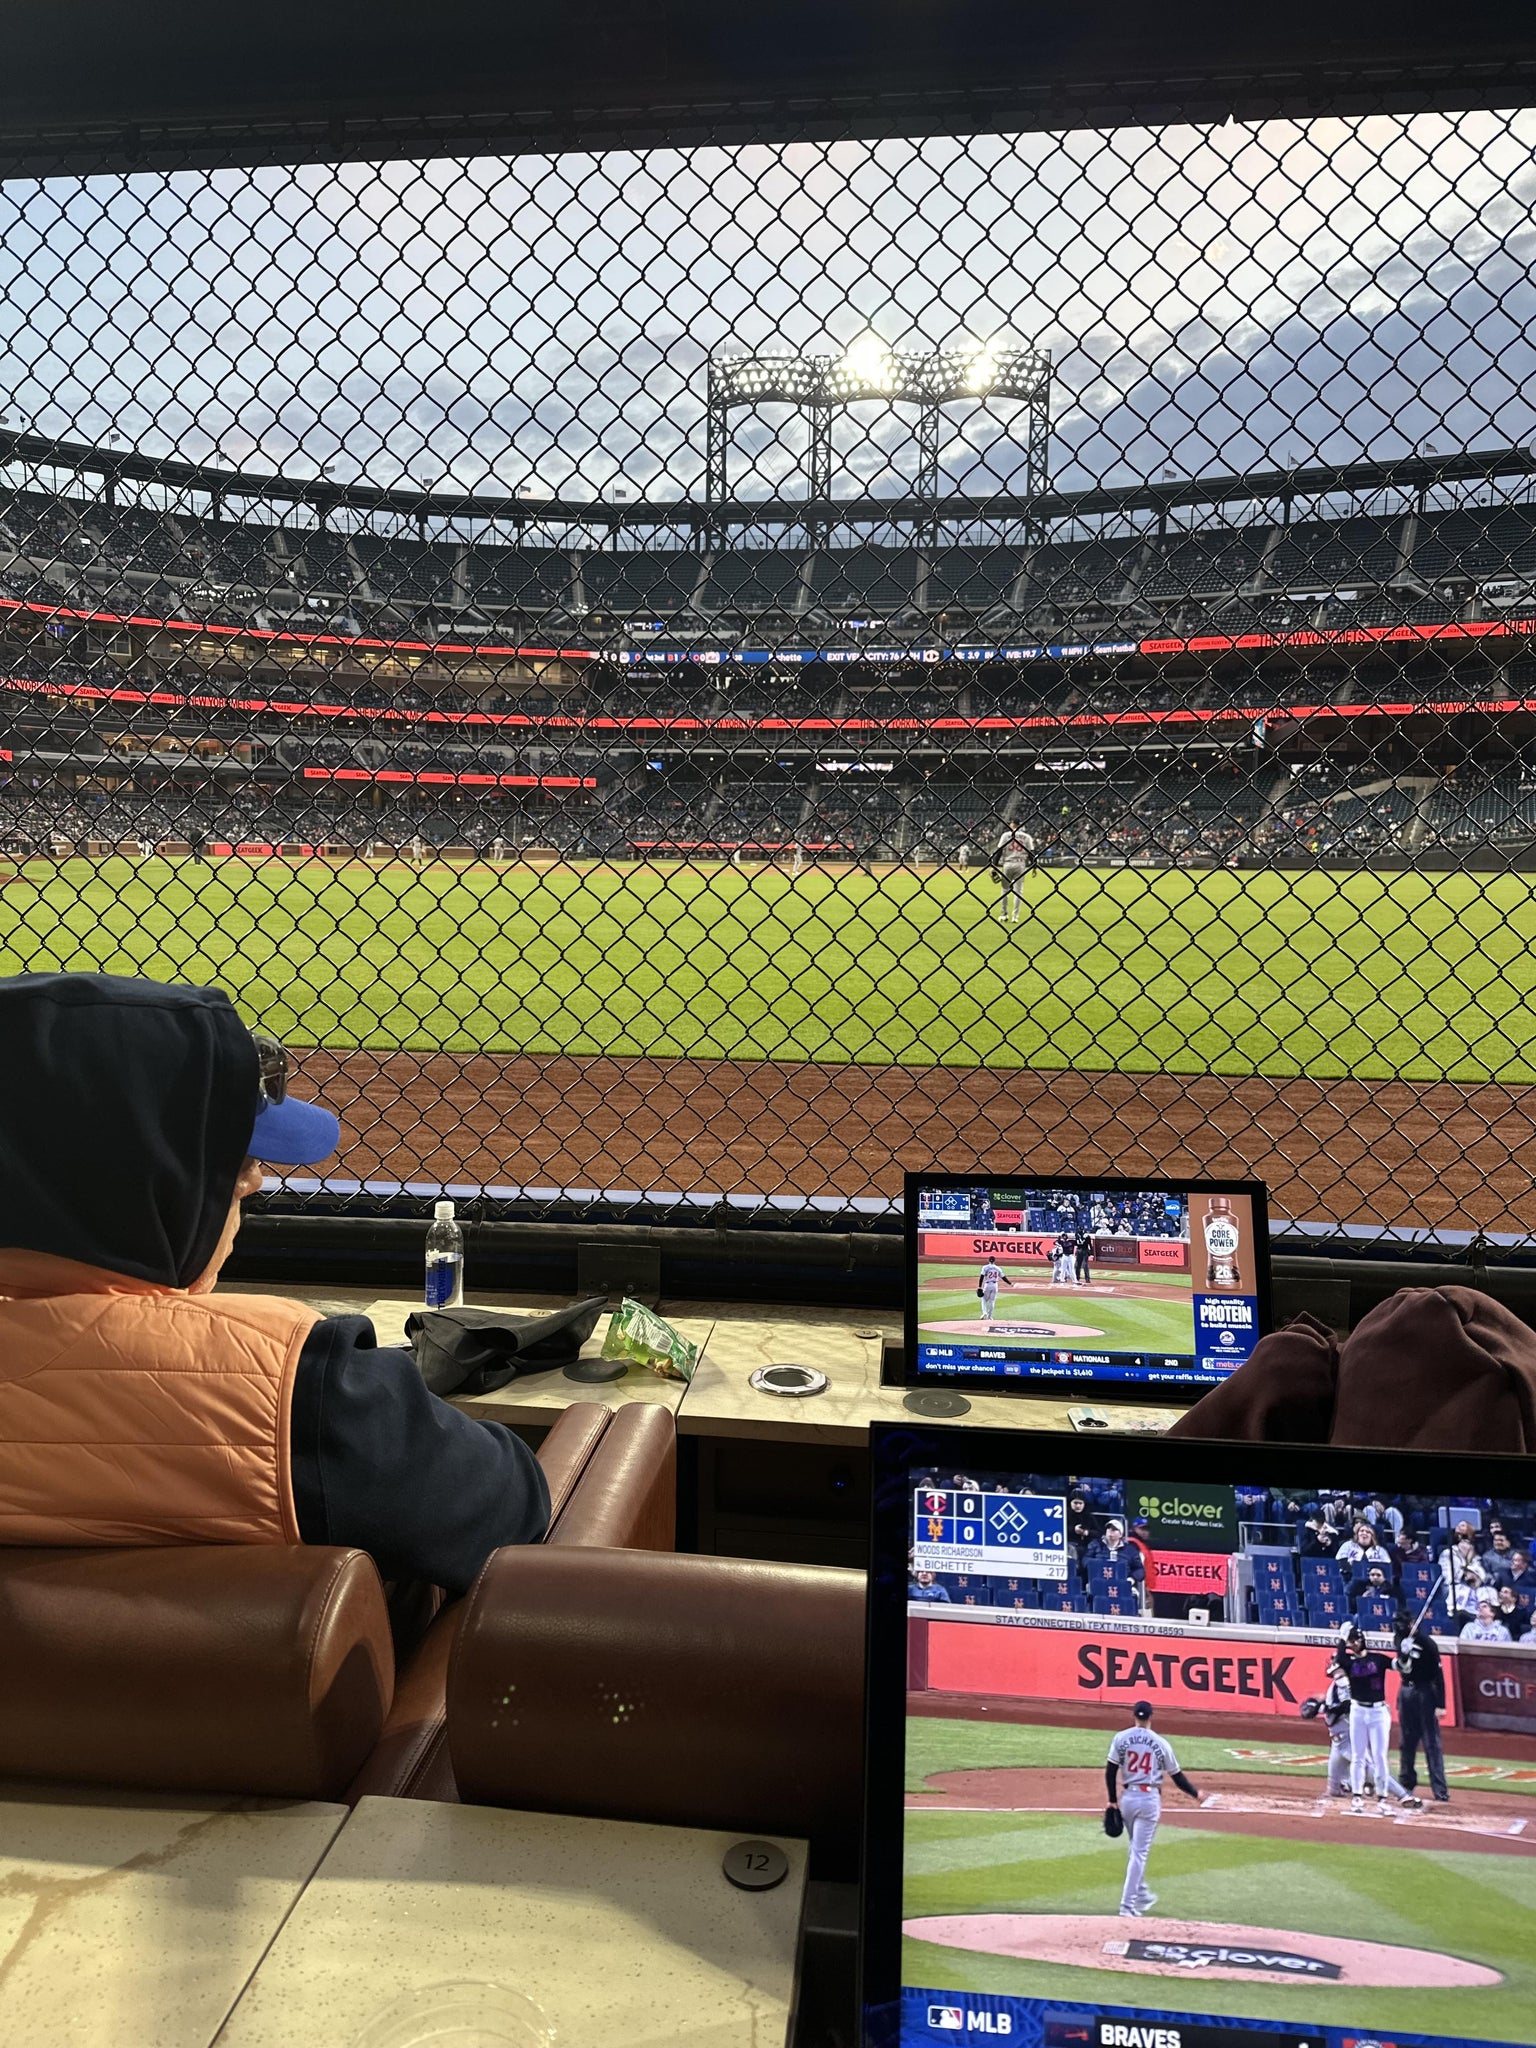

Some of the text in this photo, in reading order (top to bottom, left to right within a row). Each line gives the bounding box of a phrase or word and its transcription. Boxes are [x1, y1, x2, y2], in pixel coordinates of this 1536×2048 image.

[769, 652, 802, 662] Bchette
[996, 1212, 1021, 1220] SEATGEEK
[1209, 1239, 1235, 1247] POWER
[1211, 1230, 1231, 1239] CORE
[973, 1239, 1044, 1256] SEATGEEK
[1100, 1244, 1115, 1253] citi
[1144, 1249, 1179, 1258] SEATGEEK
[988, 1271, 998, 1279] 24
[1221, 1298, 1245, 1306] quality
[1200, 1304, 1252, 1323] PROTEIN
[980, 1351, 1006, 1359] BRAVES
[1073, 1354, 1110, 1364] NATIONALS
[1164, 1359, 1179, 1367] 2ND
[1041, 1367, 1065, 1376] jackpot
[1148, 1373, 1160, 1381] get
[1176, 1373, 1193, 1381] raffle
[1194, 1374, 1215, 1382] tickets
[963, 1499, 975, 1513] 0
[1053, 1505, 1063, 1519] 2
[1161, 1497, 1224, 1519] clover
[963, 1526, 975, 1541] 0
[1037, 1531, 1063, 1546] 1-0
[917, 1544, 1064, 1563] WOODS RICHARDSON 91 MPH
[924, 1560, 974, 1572] BICHETTE
[1046, 1567, 1065, 1577] .217
[1154, 1561, 1223, 1581] SEATGEEK
[995, 1614, 1185, 1636] STAY CONNECTED TEXT METS TO 48593
[1078, 1643, 1299, 1704] SEATGEEK
[1479, 1675, 1521, 1699] citi
[1127, 1750, 1152, 1775] 24
[744, 1853, 770, 1872] 12
[1191, 1948, 1325, 1973] clover
[967, 2010, 1182, 2048] MLB BRAVES
